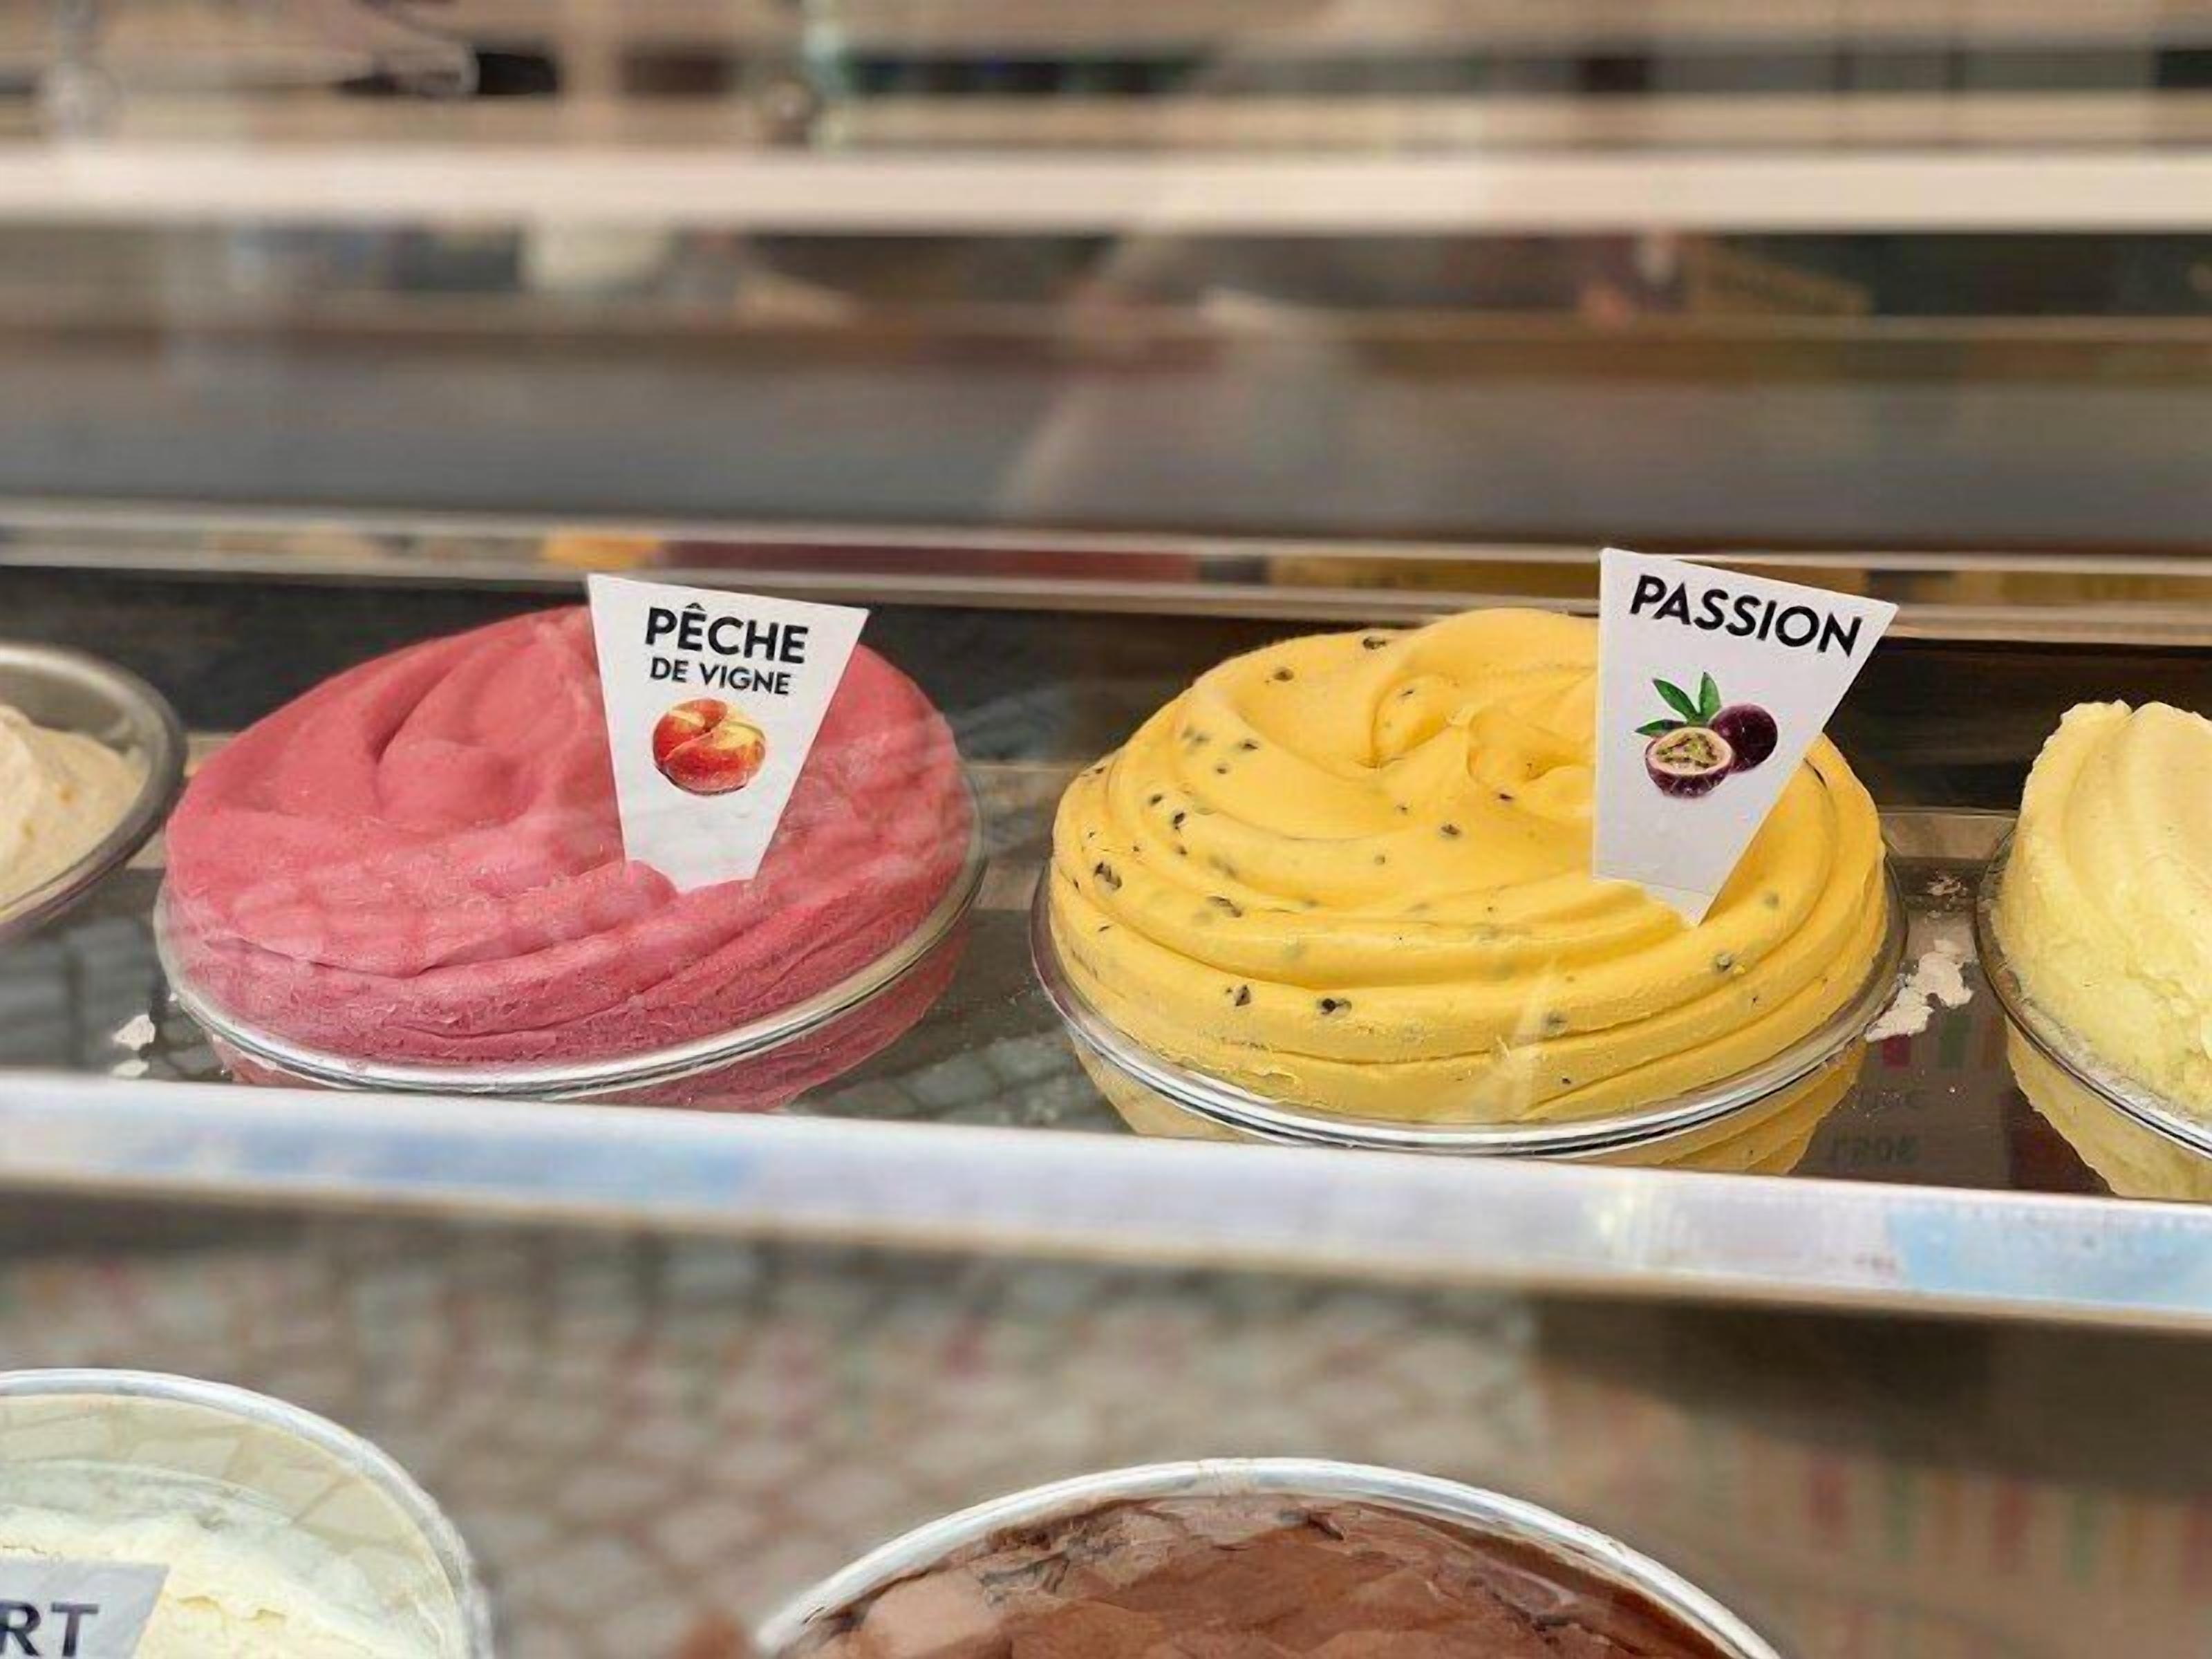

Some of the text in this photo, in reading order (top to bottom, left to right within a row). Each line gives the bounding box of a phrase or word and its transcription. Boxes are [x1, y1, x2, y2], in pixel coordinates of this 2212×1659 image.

[644, 602, 809, 664] PÊCHE
[1629, 574, 1863, 657] PASSION
[650, 656, 791, 695] DE VIGNE
